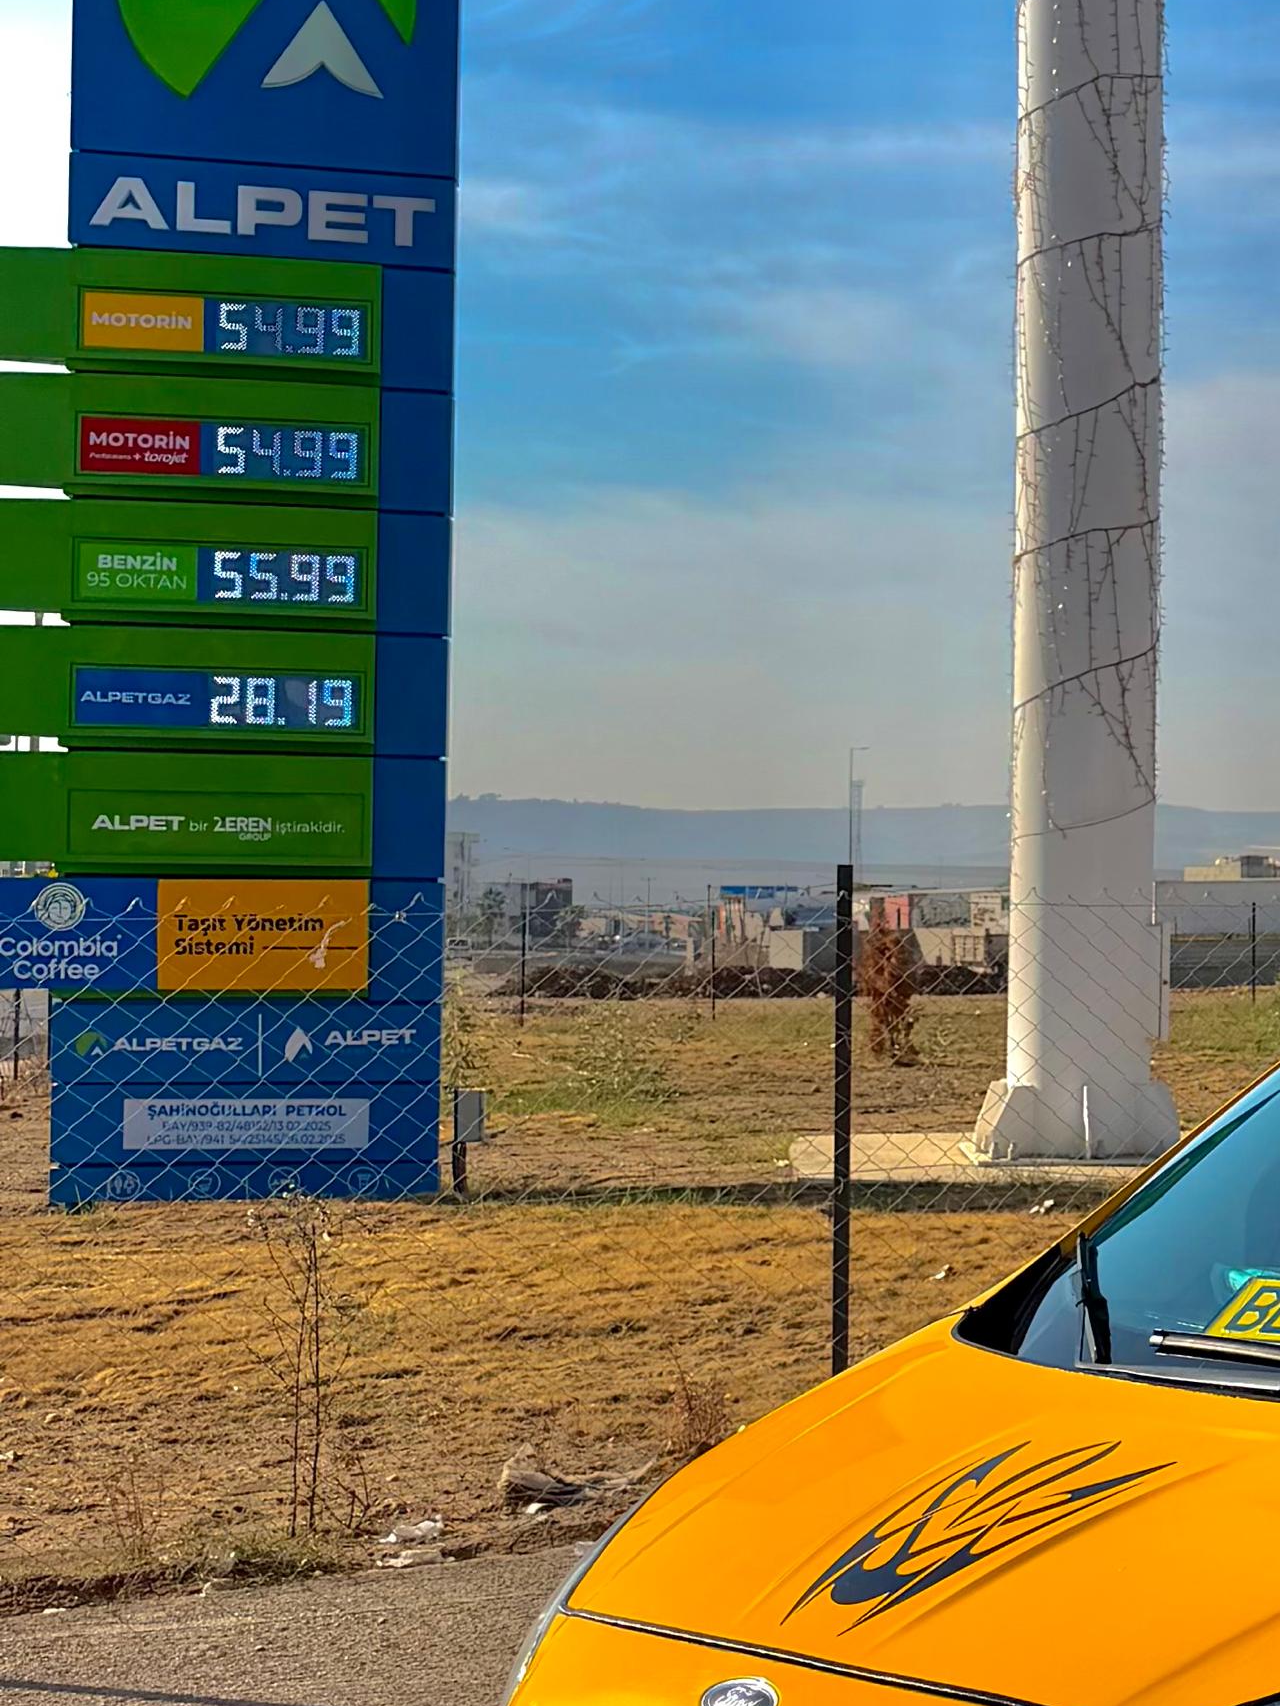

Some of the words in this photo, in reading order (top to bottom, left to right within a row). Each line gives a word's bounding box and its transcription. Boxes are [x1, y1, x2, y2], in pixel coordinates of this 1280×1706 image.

[89, 176, 436, 247] ALPET
[91, 311, 192, 330] MOTORİN
[219, 302, 360, 356] 54.99
[89, 431, 191, 451] MOTORİN
[217, 426, 358, 480] 54.99
[97, 553, 178, 571] BENZİN
[86, 572, 110, 588] 95
[116, 573, 187, 590] OKTAN
[215, 551, 355, 603] 55.99
[80, 690, 191, 706] ALPETGAZ
[210, 676, 352, 728] 28.19
[92, 815, 185, 831] ALPET
[190, 820, 208, 832] bir
[235, 913, 324, 933] Yönetim
[0, 936, 118, 957] Colombia
[174, 936, 255, 957] Sistemi
[13, 959, 100, 981] Coffee
[113, 1036, 244, 1053] ALPETGAZ
[325, 1029, 417, 1046] ALPET
[286, 1104, 347, 1117] PETROL
